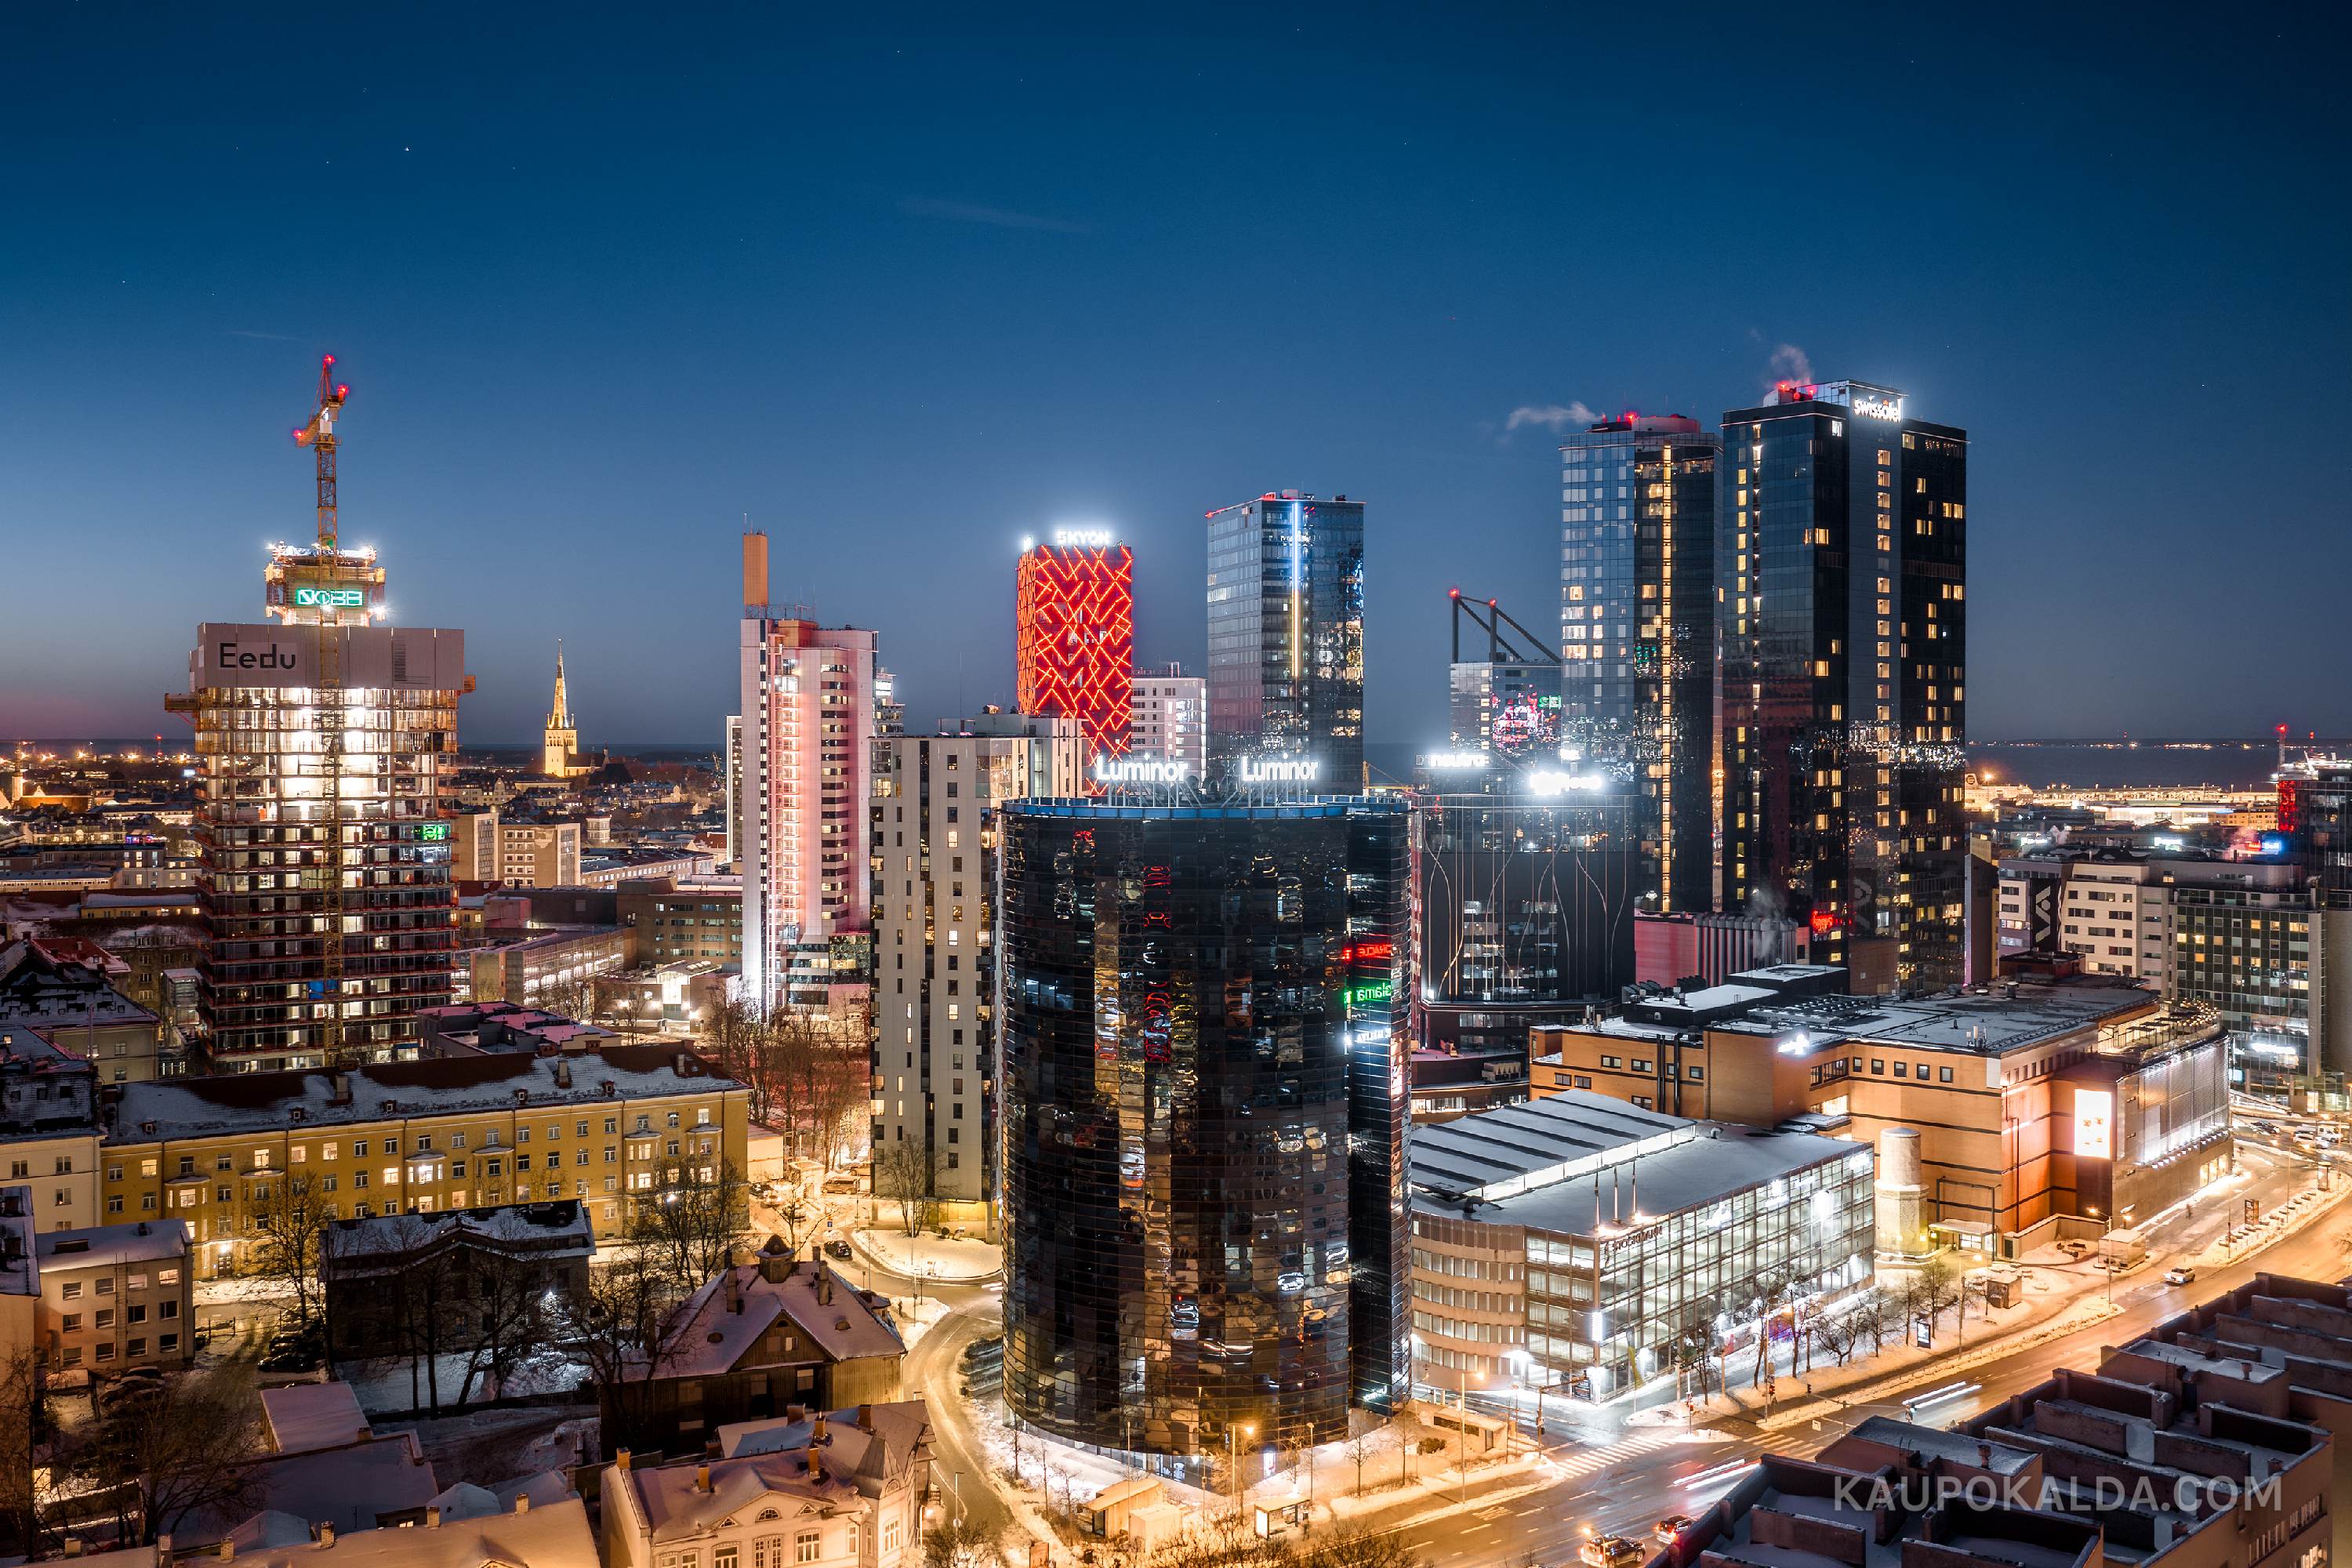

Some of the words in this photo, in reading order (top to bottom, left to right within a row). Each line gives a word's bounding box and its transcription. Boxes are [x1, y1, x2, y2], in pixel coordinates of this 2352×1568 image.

[220, 642, 296, 670] Eedu
[1097, 753, 1189, 782] Luminor
[1241, 753, 1319, 782] Luminor
